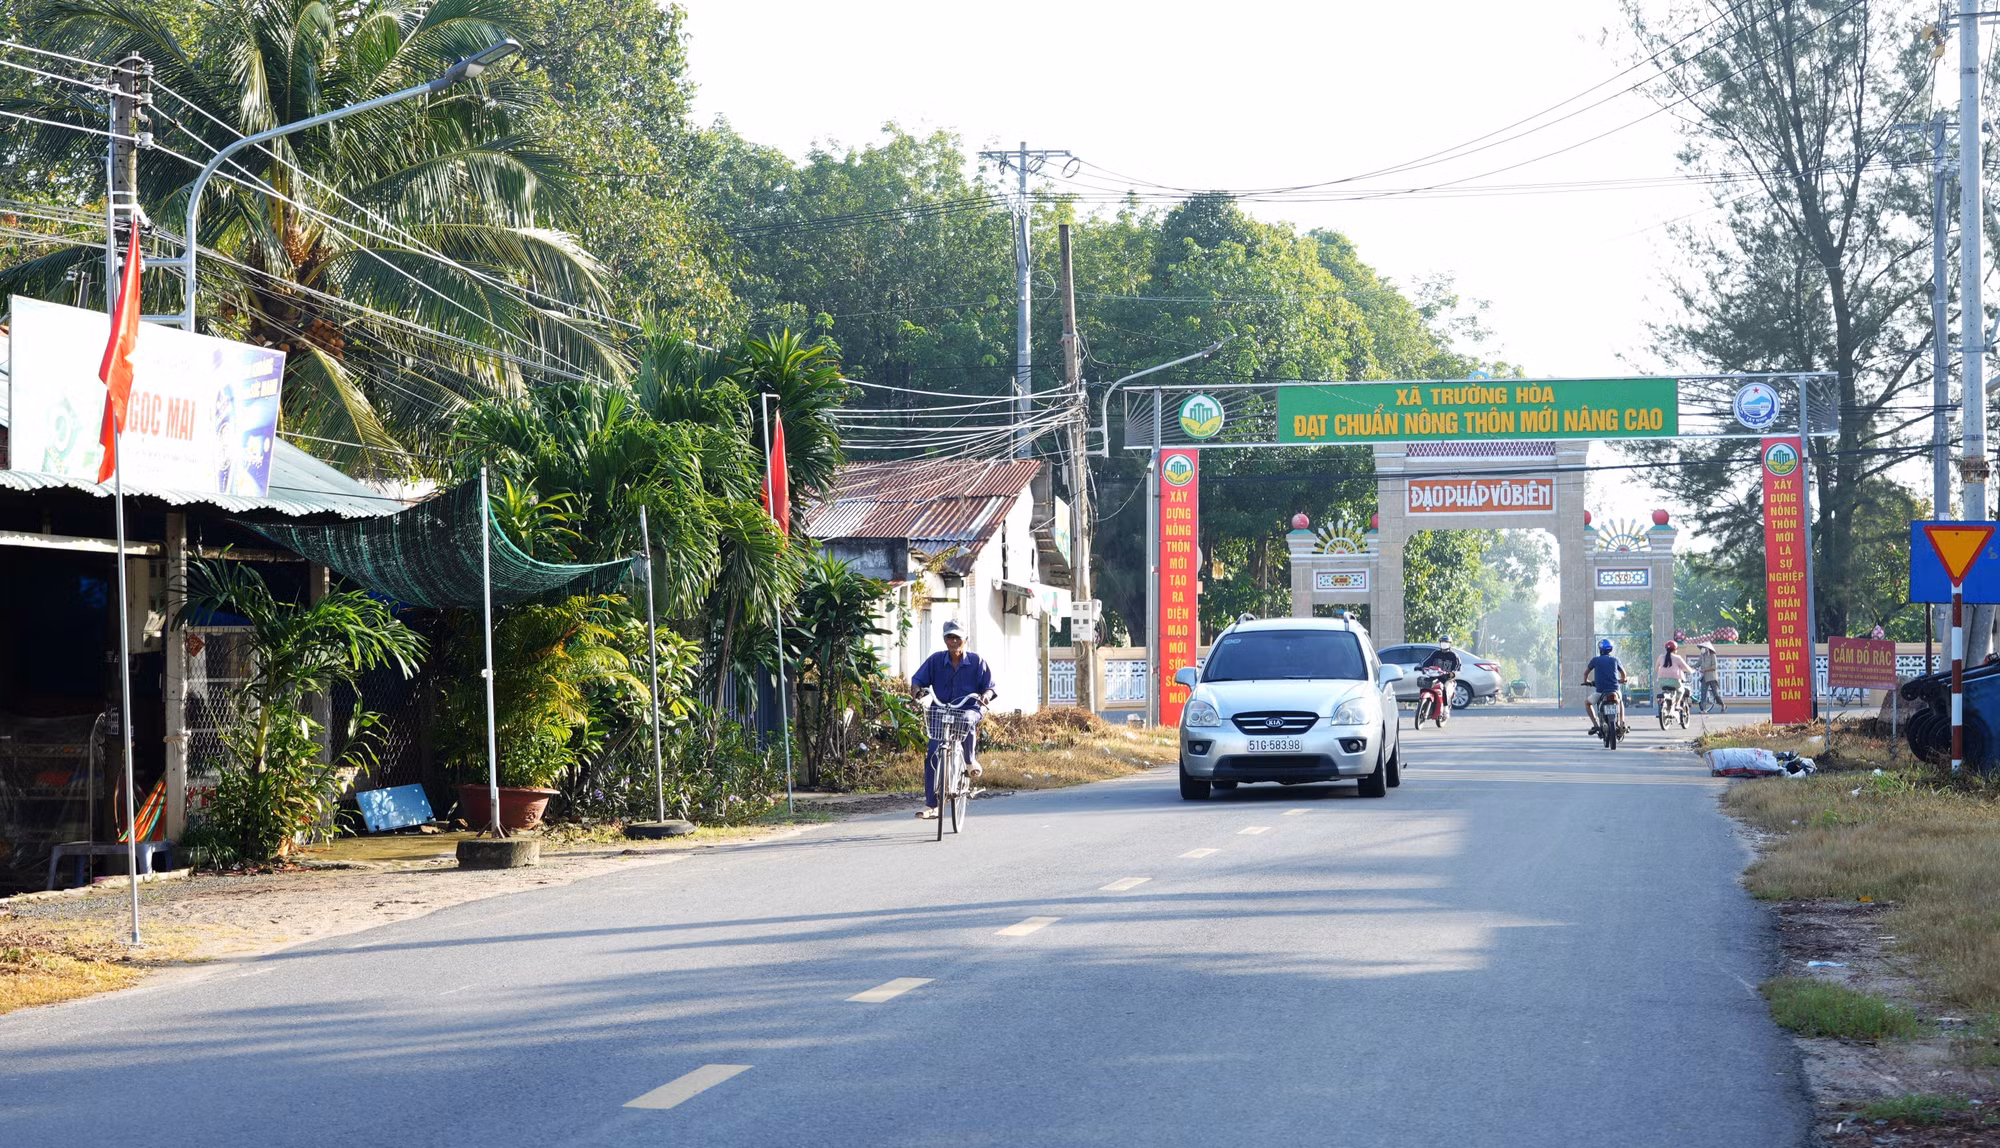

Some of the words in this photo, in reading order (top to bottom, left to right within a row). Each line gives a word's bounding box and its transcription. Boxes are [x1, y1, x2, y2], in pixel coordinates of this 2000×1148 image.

[1396, 386, 1423, 406] XÃ
[1430, 383, 1508, 405] TRƯỜNG
[1516, 382, 1555, 403] HÒA
[122, 389, 162, 443] GỌC
[165, 395, 196, 442] MAI
[1294, 414, 1328, 441] ĐẠT
[1334, 403, 1398, 436] CHUẨN
[1405, 407, 1458, 434] NÔNG
[1464, 407, 1515, 434] THÔN
[1520, 405, 1558, 433] MỚI
[1564, 405, 1619, 432] NÂNG
[1624, 408, 1663, 431] CAO
[1773, 479, 1793, 490] XÂY
[1170, 489, 1188, 503] XÂY
[1411, 485, 1444, 511] ĐẠO
[1444, 480, 1489, 507] PHÁP
[1511, 480, 1550, 506] BIÊN
[1770, 493, 1797, 504] DỰNG
[1166, 506, 1191, 521] DỰNG
[1770, 505, 1798, 516] NÔNG
[1166, 523, 1191, 536] NÔNG
[1771, 518, 1797, 529] THÔN
[1775, 531, 1794, 543] MỚI
[1166, 539, 1191, 553] THÔN
[1779, 544, 1792, 556] LÀ
[1170, 555, 1187, 569] MỚI
[1779, 558, 1793, 570] SỰ
[1170, 574, 1187, 588] TẠO
[1768, 570, 1804, 583] NGHIỆP
[1777, 583, 1797, 595] CỦA
[1172, 591, 1184, 603] RA
[1774, 597, 1801, 609] NHÂN
[1167, 606, 1189, 621] DIỆN
[1777, 610, 1798, 622] DÂN
[1168, 625, 1188, 639] MẠO
[1781, 624, 1795, 634] DO
[1169, 640, 1187, 654] MỚI
[1775, 637, 1802, 648] NHÂN
[1779, 650, 1799, 661] DÂN
[1833, 642, 1854, 664] CẤM
[1856, 641, 1870, 665] ĐỔ
[1872, 646, 1892, 666] RÁC
[1169, 656, 1187, 671] SỨC
[1785, 663, 1795, 674] VÌ
[1777, 677, 1804, 688] NHÂN
[1169, 690, 1187, 704] MỚI
[1781, 689, 1801, 700] DÂN
[1249, 740, 1300, 751] 51G-583.98
